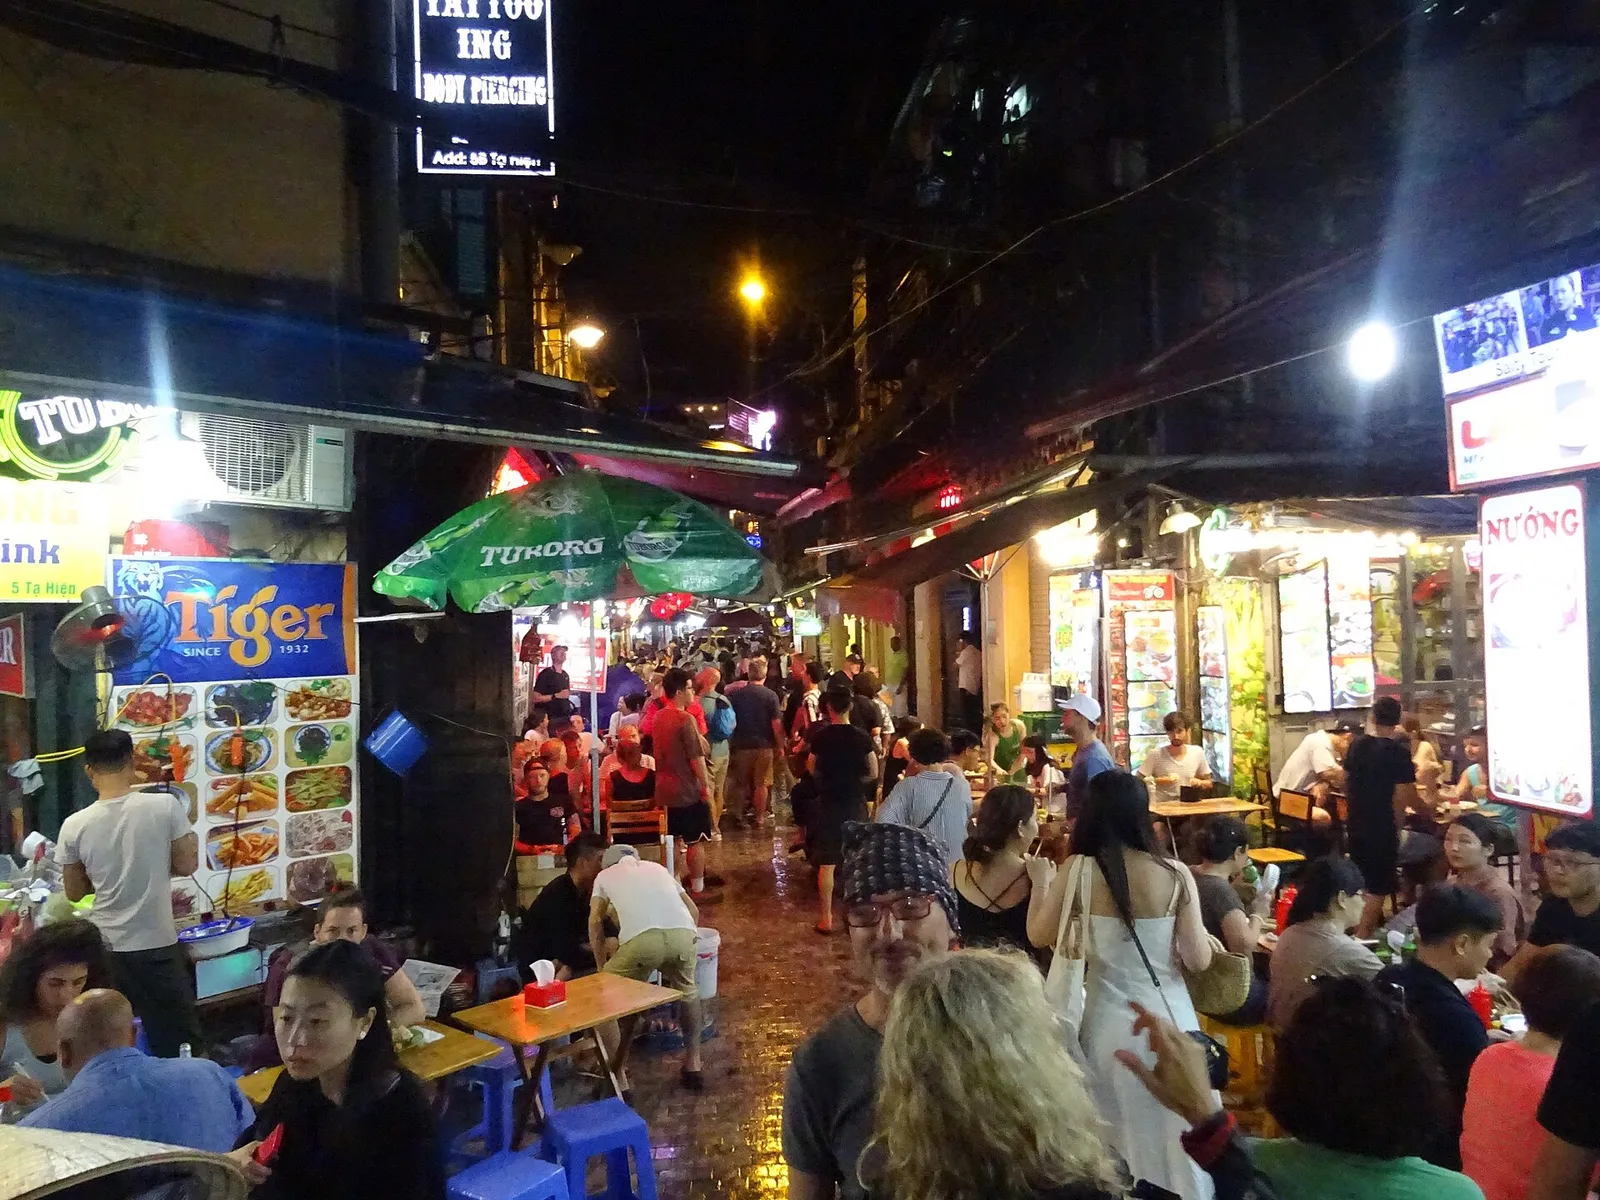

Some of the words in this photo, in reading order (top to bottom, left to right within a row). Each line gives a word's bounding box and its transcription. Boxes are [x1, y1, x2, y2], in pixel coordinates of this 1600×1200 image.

[456, 27, 512, 60] ING
[423, 73, 467, 104] BODY
[470, 75, 547, 106] PIERCING
[11, 582, 20, 595] 5
[26, 582, 41, 598] Tạ
[46, 582, 76, 598] Hiện
[164, 585, 335, 667] Tiger
[184, 645, 222, 658] SINCE
[279, 644, 309, 655] 1932
